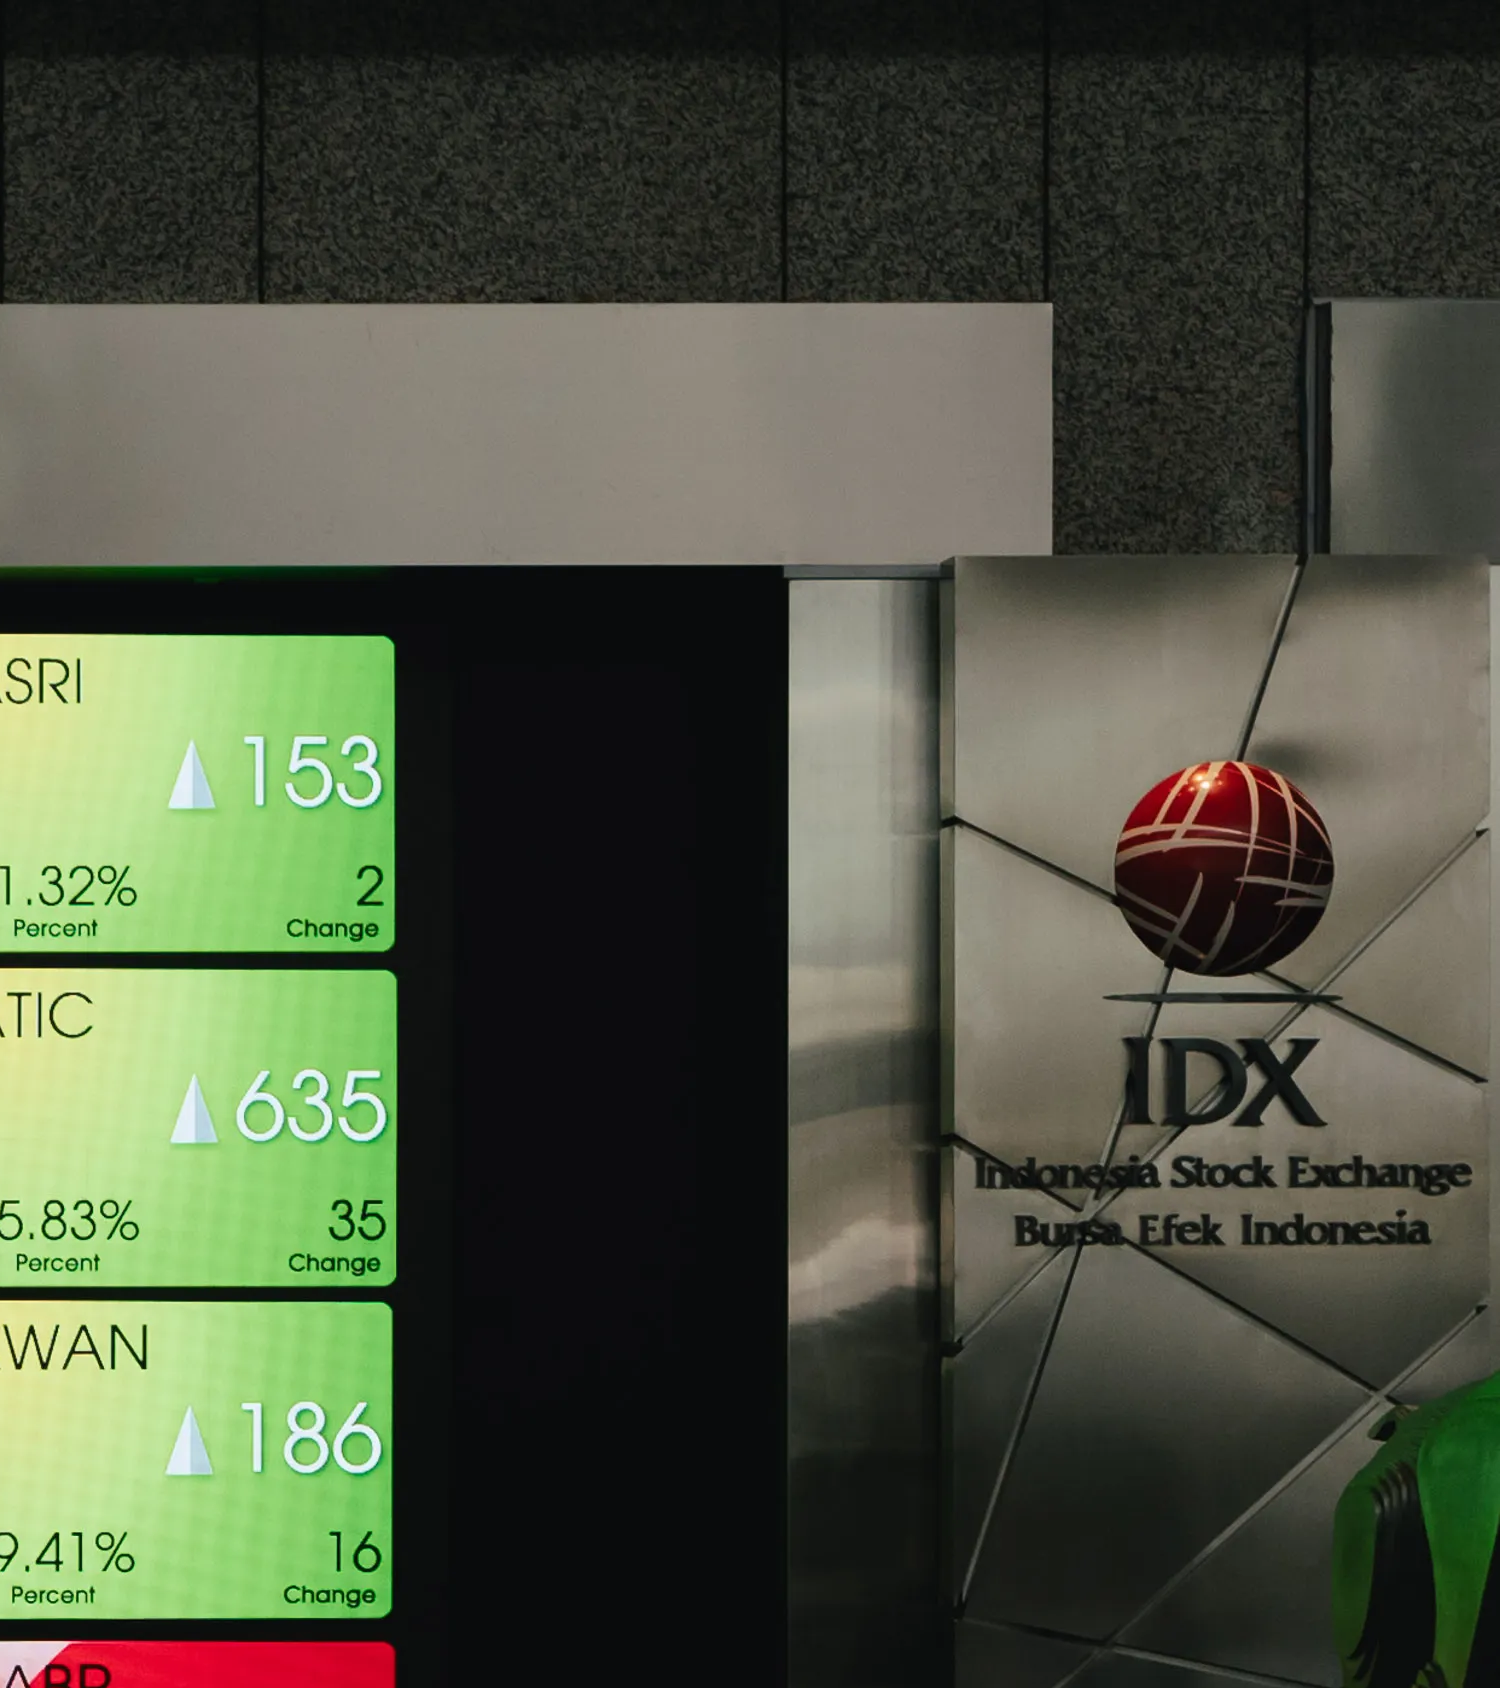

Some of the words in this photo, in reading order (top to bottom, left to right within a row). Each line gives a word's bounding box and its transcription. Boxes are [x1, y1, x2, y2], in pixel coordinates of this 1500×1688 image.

[244, 735, 384, 810] 153
[0, 866, 137, 906] 1.32%
[357, 865, 384, 906] 2
[14, 919, 98, 937] Percent
[287, 919, 379, 942] Change
[1123, 1036, 1328, 1128] IDX
[236, 1069, 390, 1144] 635
[974, 1154, 1161, 1189] Indonesia
[1171, 1154, 1277, 1189] Stock
[1288, 1154, 1472, 1197] Exchange
[329, 1199, 386, 1241] 35
[1014, 1213, 1125, 1248] Bursa
[1139, 1213, 1226, 1247] Efek
[1241, 1208, 1432, 1247] Indonesia
[17, 1254, 100, 1272] Percent
[289, 1253, 381, 1276] Change
[242, 1402, 384, 1477] 186
[329, 1531, 382, 1572] 16
[12, 1586, 95, 1604] Percent
[284, 1585, 376, 1608] Change
